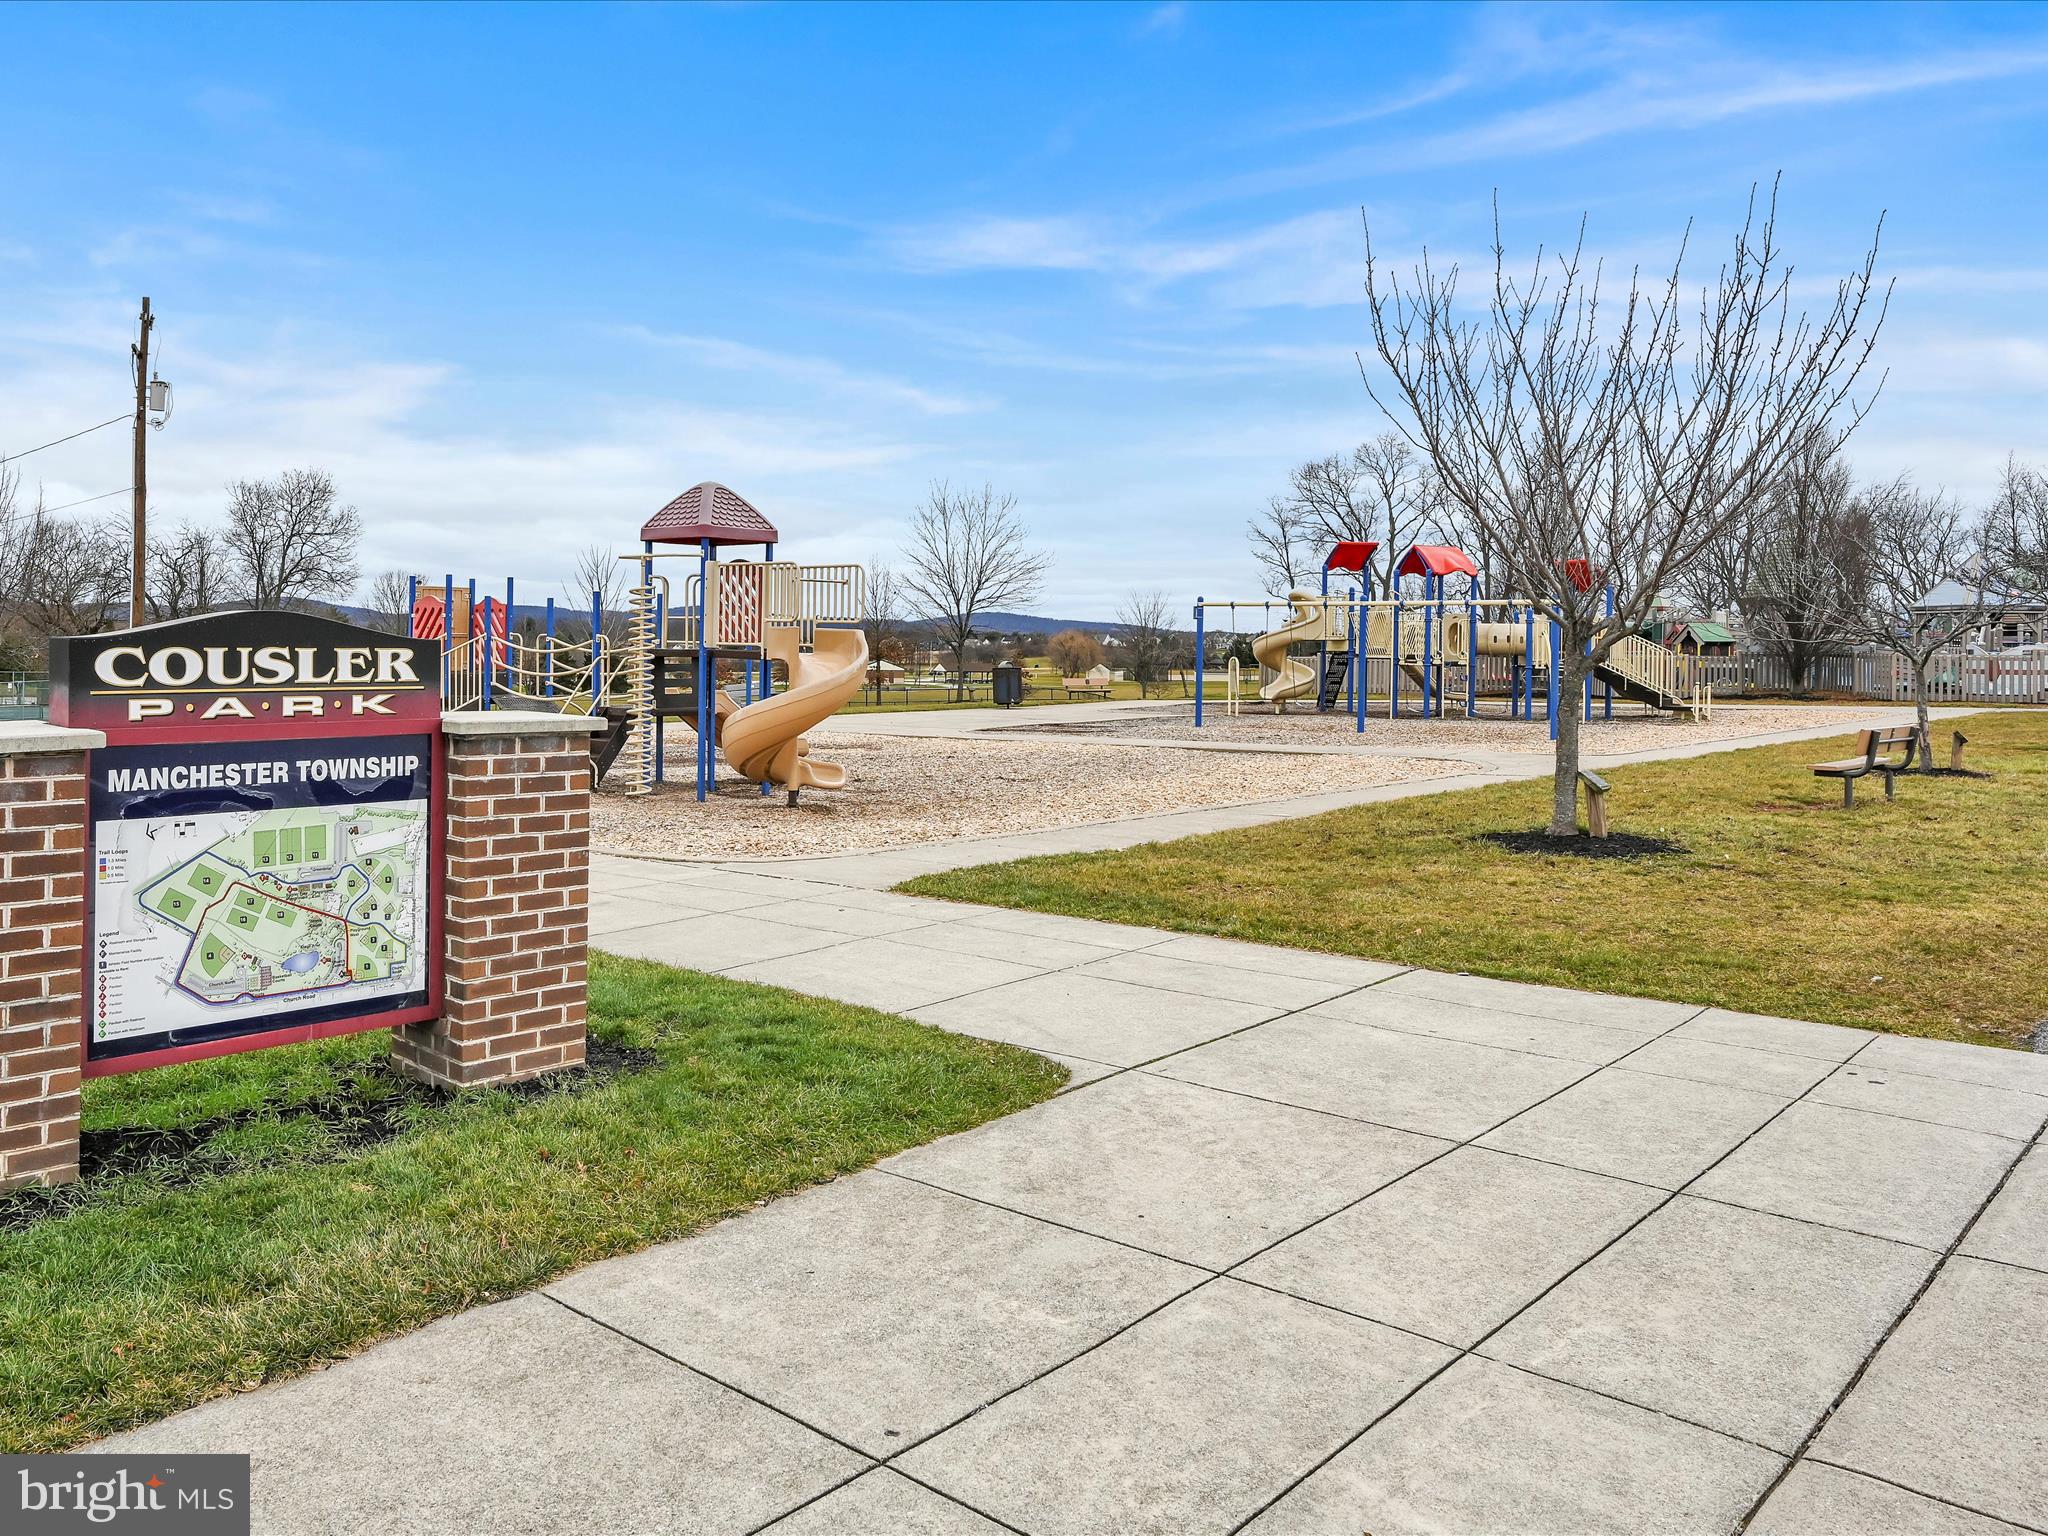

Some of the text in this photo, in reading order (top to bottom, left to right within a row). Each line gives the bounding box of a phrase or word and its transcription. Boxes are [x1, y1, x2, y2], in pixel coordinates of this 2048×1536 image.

[93, 645, 420, 688] COUSLER
[107, 755, 419, 794] MANCHESTER TOWNSHIP
